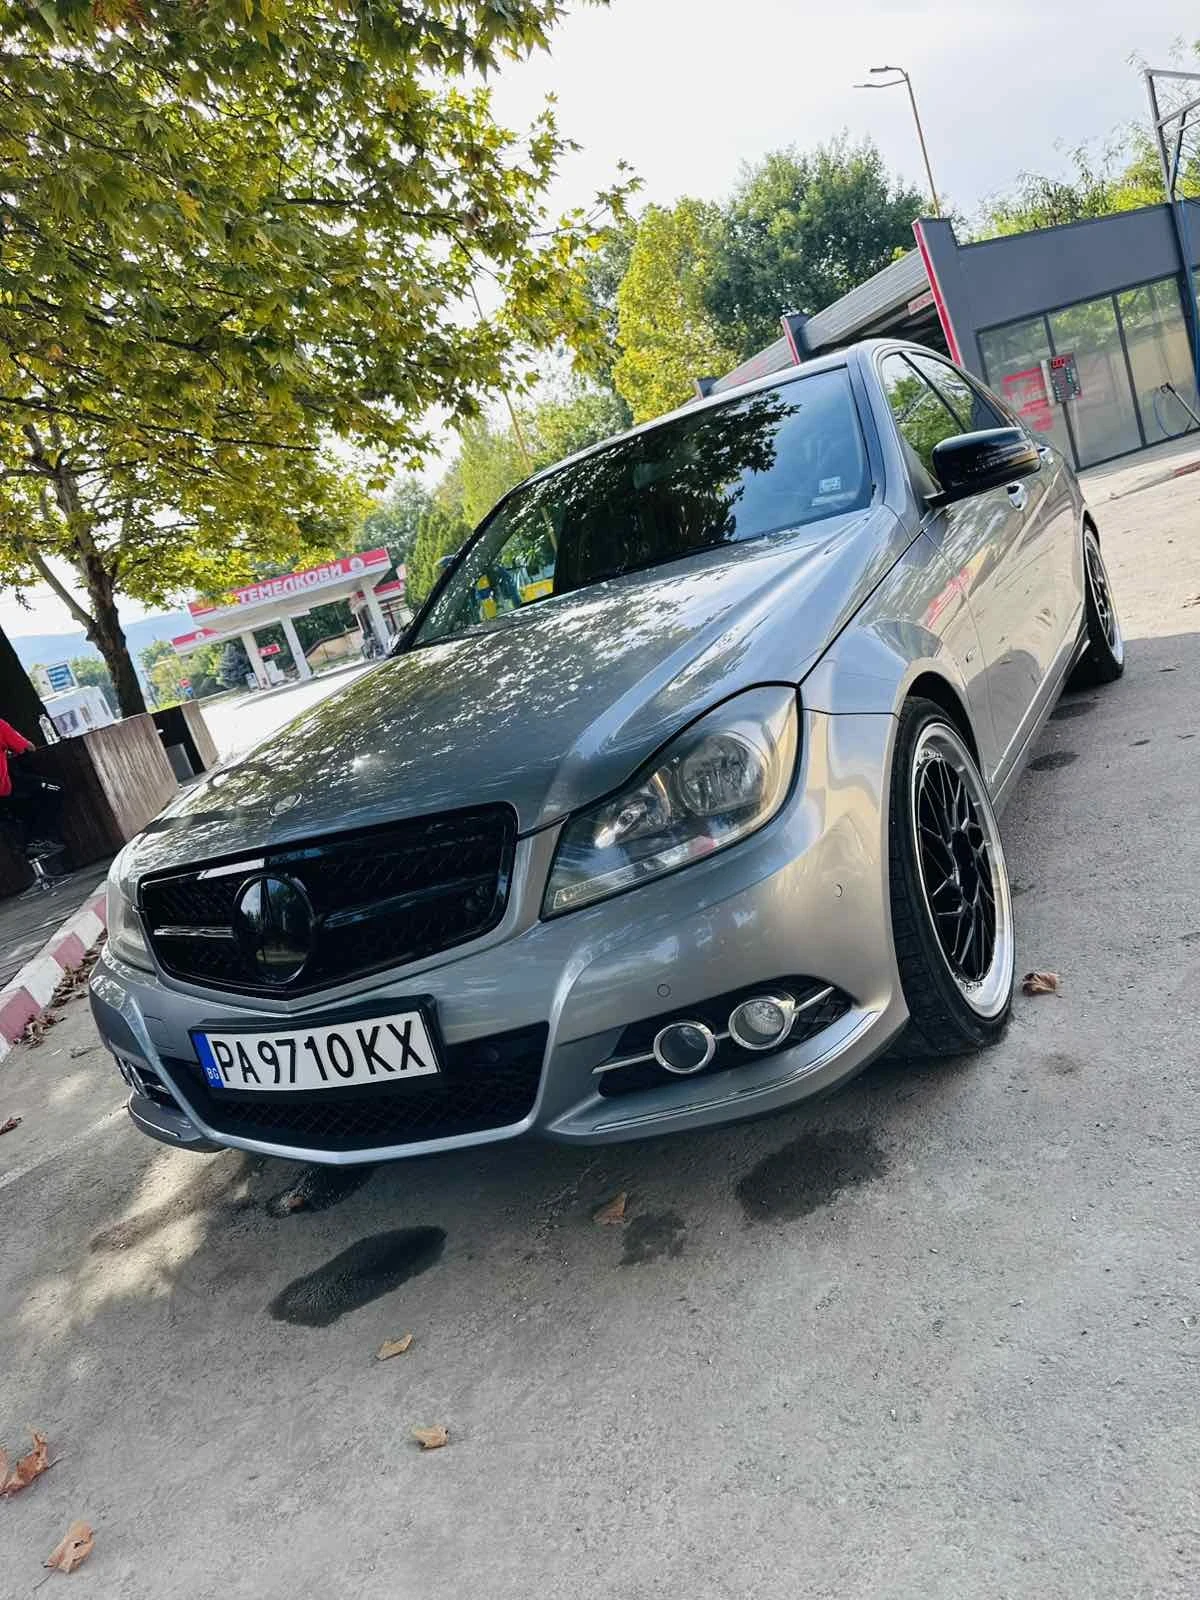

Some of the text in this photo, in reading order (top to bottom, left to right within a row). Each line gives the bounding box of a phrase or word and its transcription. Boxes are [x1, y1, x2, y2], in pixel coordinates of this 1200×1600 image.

[239, 564, 343, 603] ТЕМЕЛКОВИ
[212, 1020, 427, 1084] PA9710KX
[206, 1067, 220, 1080] BG
